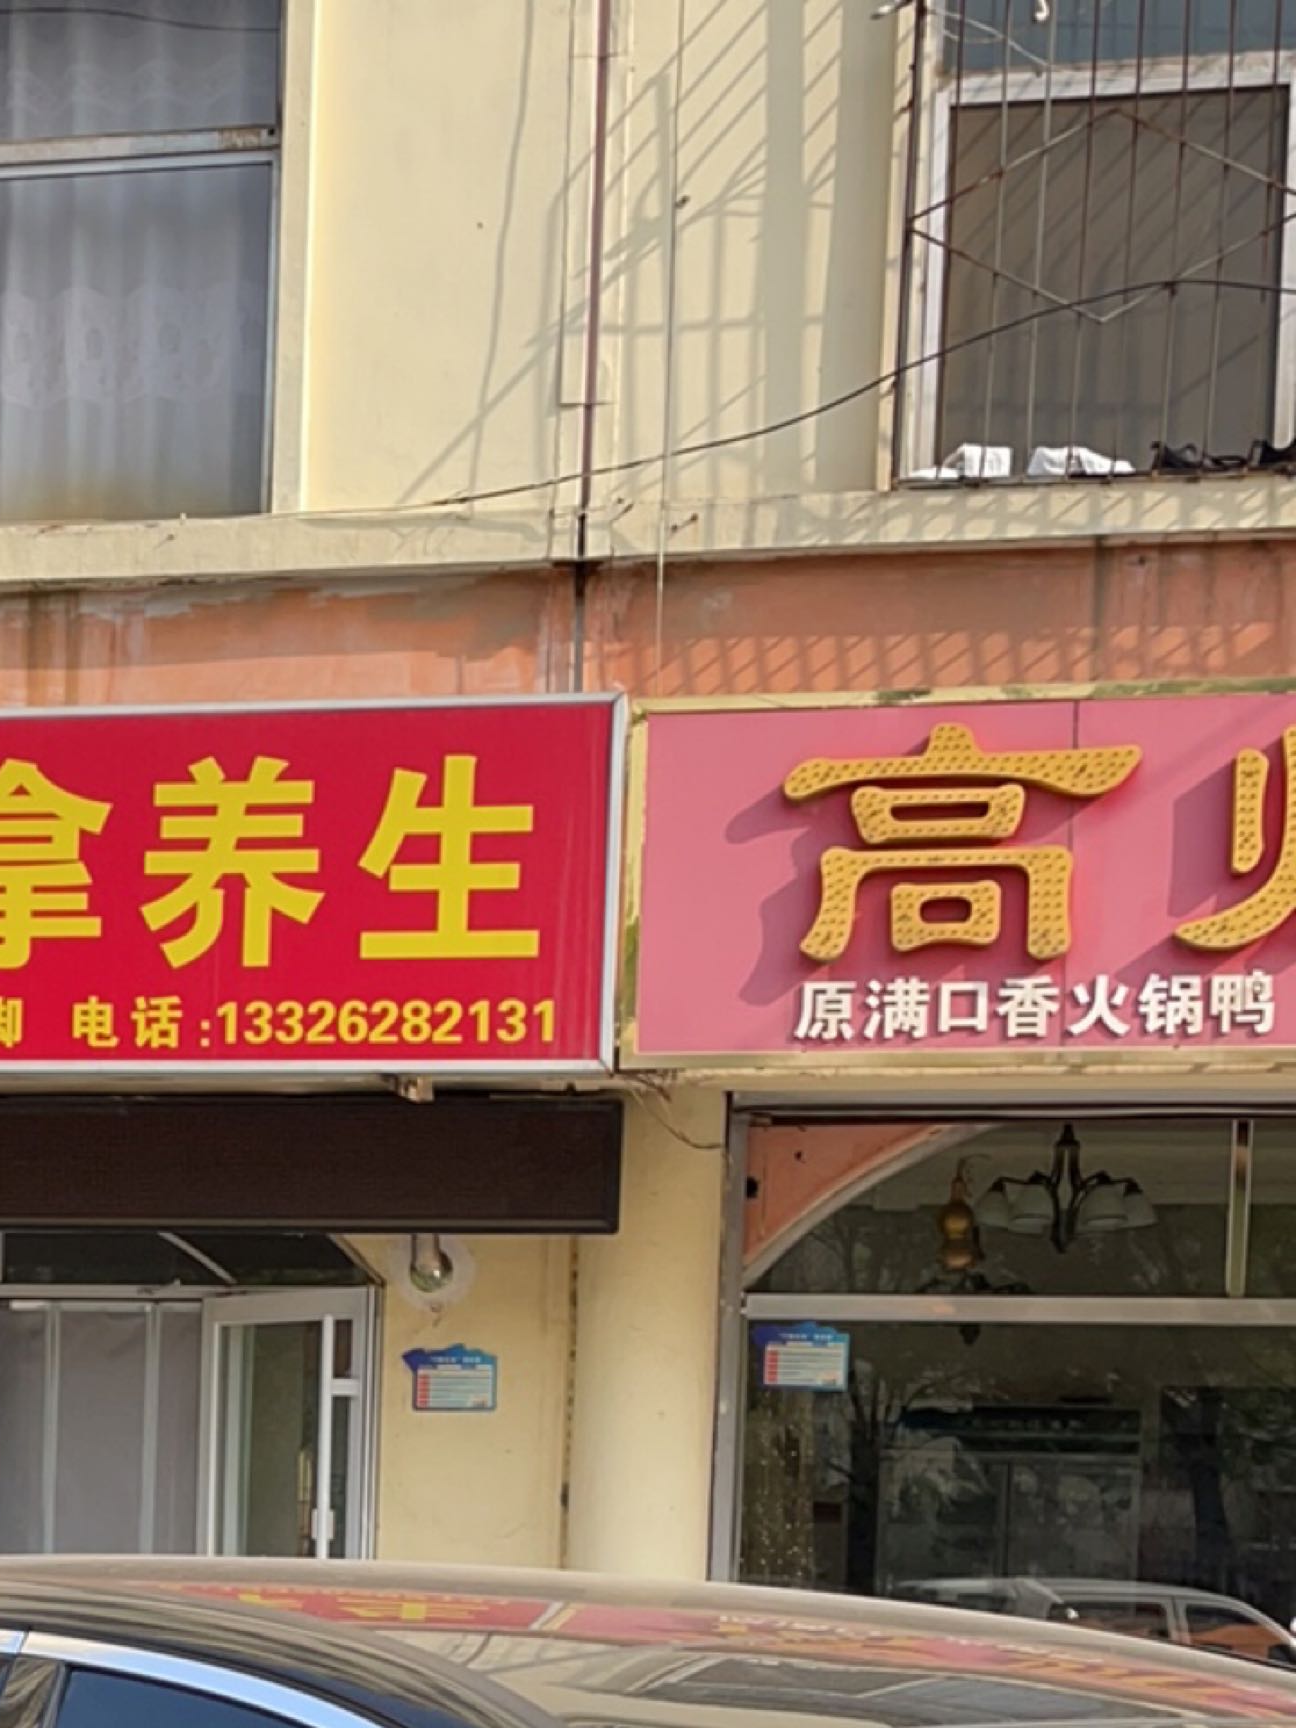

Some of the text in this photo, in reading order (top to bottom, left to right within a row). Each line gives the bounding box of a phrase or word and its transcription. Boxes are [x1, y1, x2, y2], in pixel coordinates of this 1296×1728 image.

[794, 968, 1276, 1041] 原满口香火锅鸭
